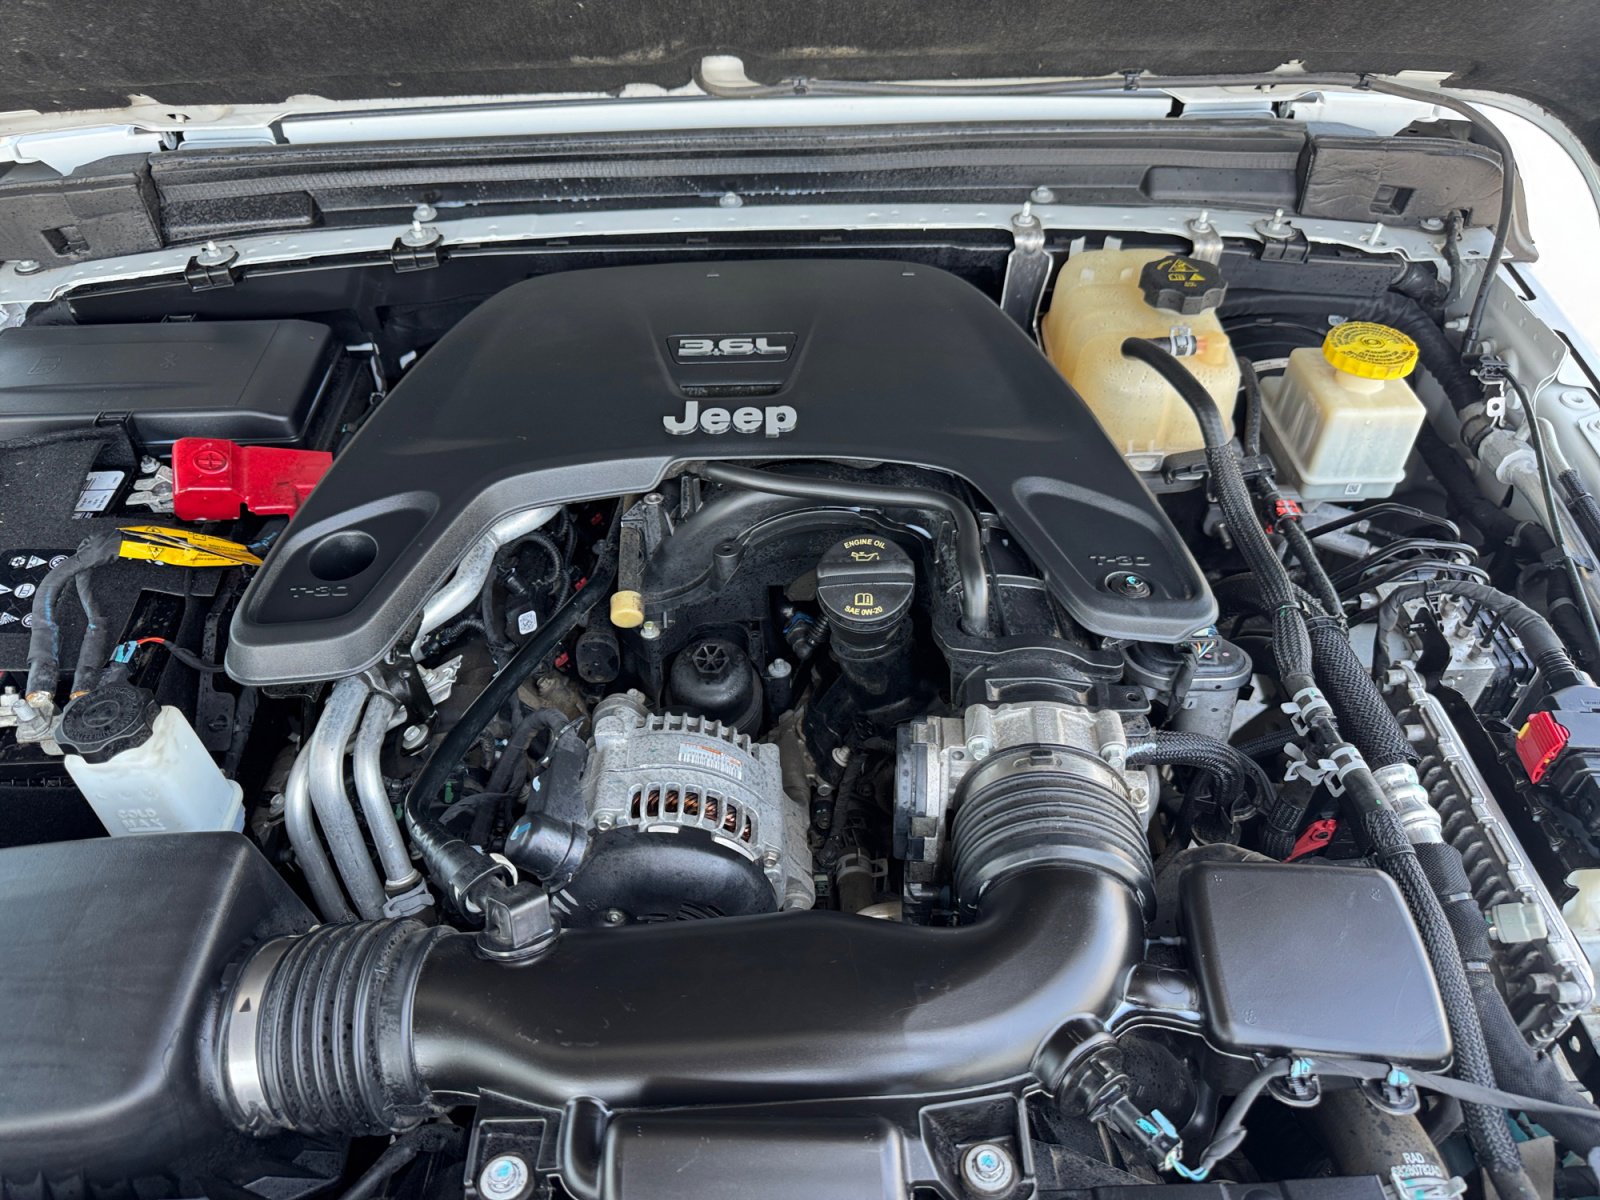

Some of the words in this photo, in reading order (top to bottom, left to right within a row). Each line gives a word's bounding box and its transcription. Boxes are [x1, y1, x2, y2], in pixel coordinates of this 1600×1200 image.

[678, 337, 787, 356] 3.6L
[662, 400, 798, 438] Jeep
[843, 538, 873, 549] ENGINE
[873, 539, 887, 550] OIL
[844, 605, 860, 615] SAE
[861, 605, 883, 616] 0W-20
[118, 807, 157, 818] COLD
[1402, 1151, 1425, 1164] RAD
